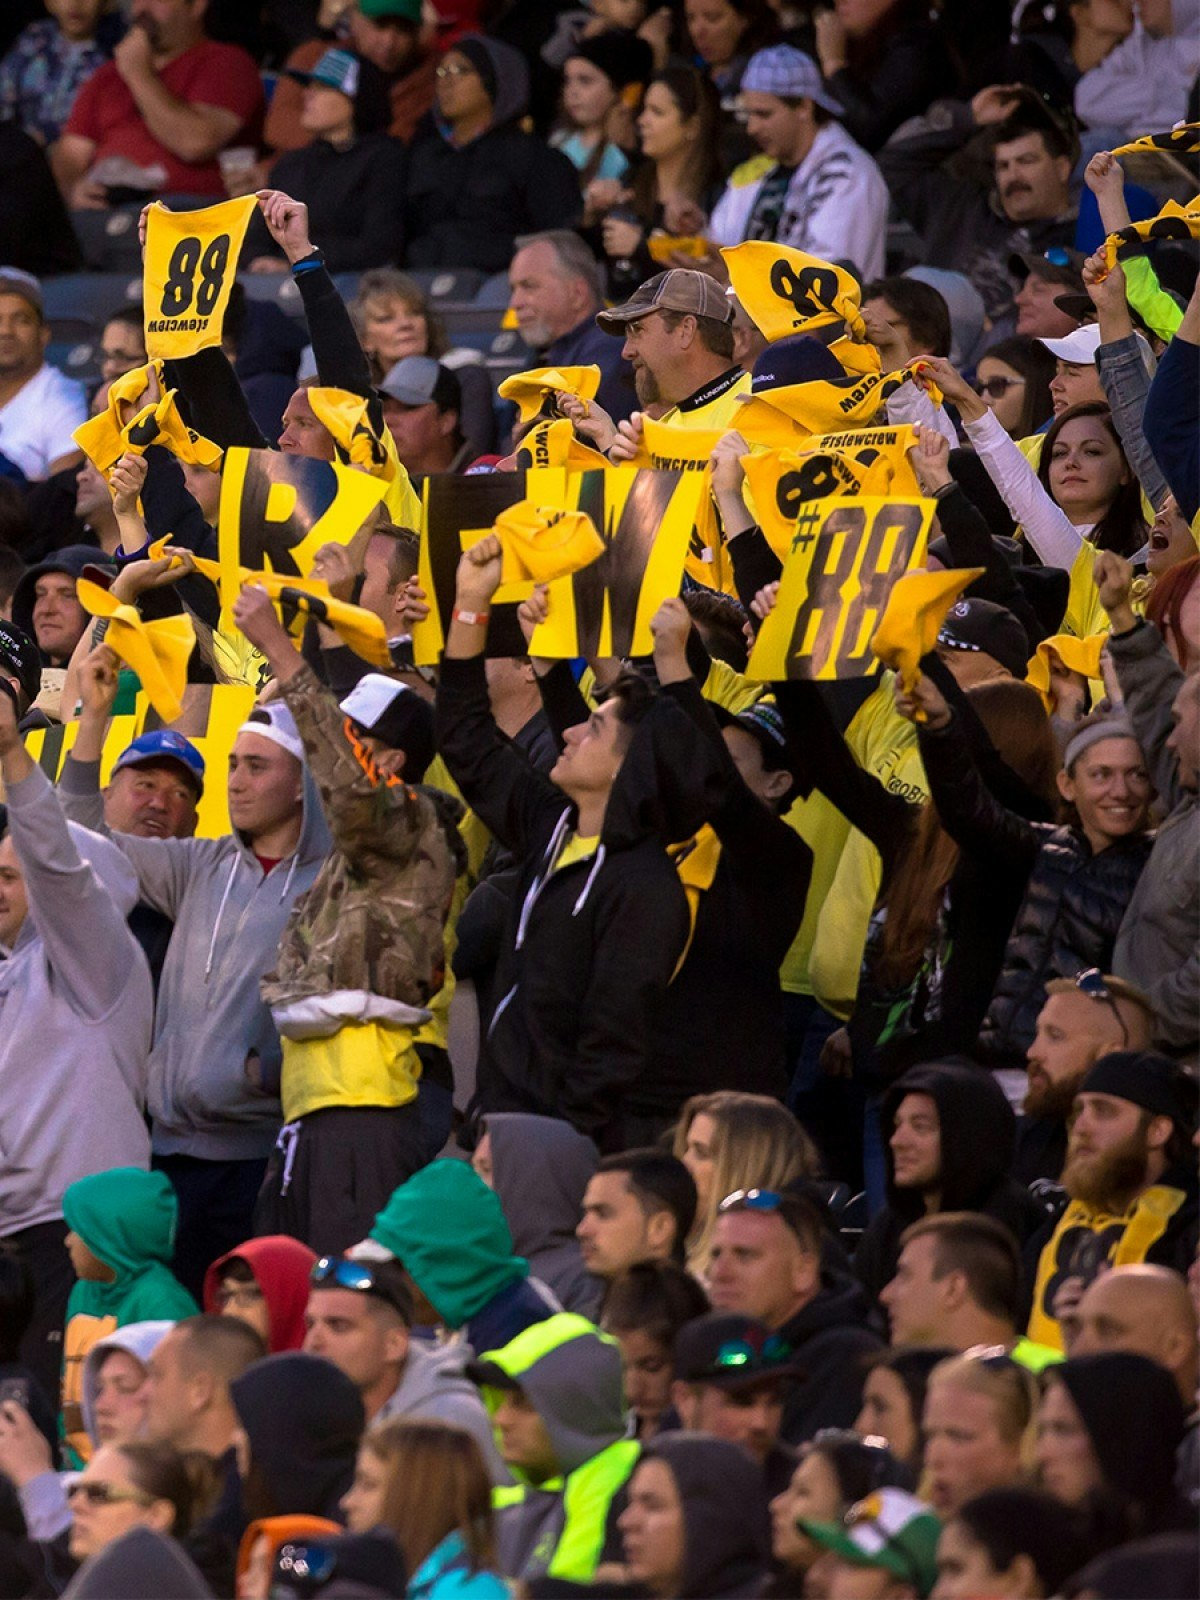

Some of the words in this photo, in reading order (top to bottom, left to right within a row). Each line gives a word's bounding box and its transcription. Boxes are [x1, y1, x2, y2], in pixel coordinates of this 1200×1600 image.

[160, 234, 230, 316] 88
[238, 448, 339, 625] R
[571, 467, 685, 658] W
[785, 504, 924, 681] #88
